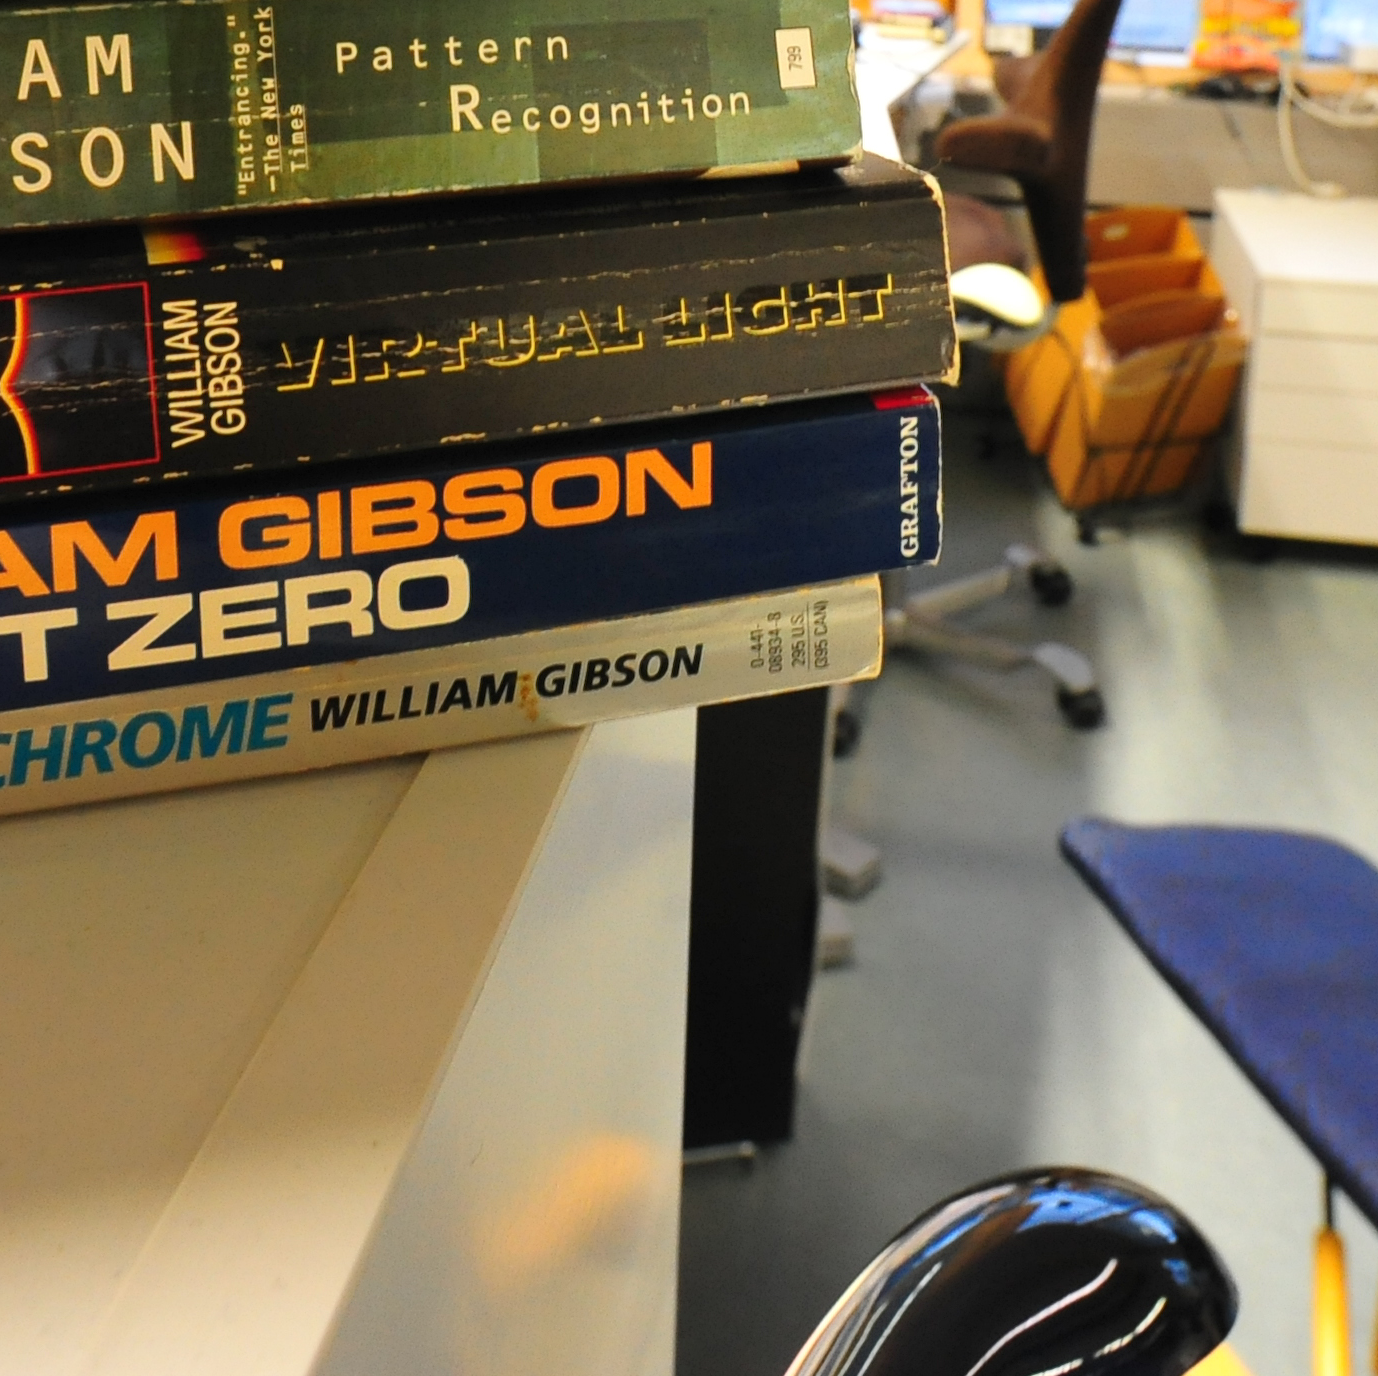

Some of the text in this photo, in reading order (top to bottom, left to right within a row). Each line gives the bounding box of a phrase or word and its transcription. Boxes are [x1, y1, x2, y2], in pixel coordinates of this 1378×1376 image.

[253, 6, 274, 63] York
[335, 33, 570, 74] Pattern
[787, 45, 802, 72] 799
[227, 15, 255, 196] "Entrancing."
[260, 77, 280, 120] New
[288, 103, 309, 173] Times
[449, 83, 752, 135] Recognition
[162, 299, 206, 449] WILLIAM
[203, 300, 247, 437] GIBSON
[277, 273, 894, 392] VIRTUAL LIGHT
[219, 441, 713, 570] GIBSON
[899, 416, 918, 558] GRAFTON
[106, 555, 471, 671] ZERO
[310, 670, 519, 734] WILLIAM
[536, 643, 705, 699] GIBSON
